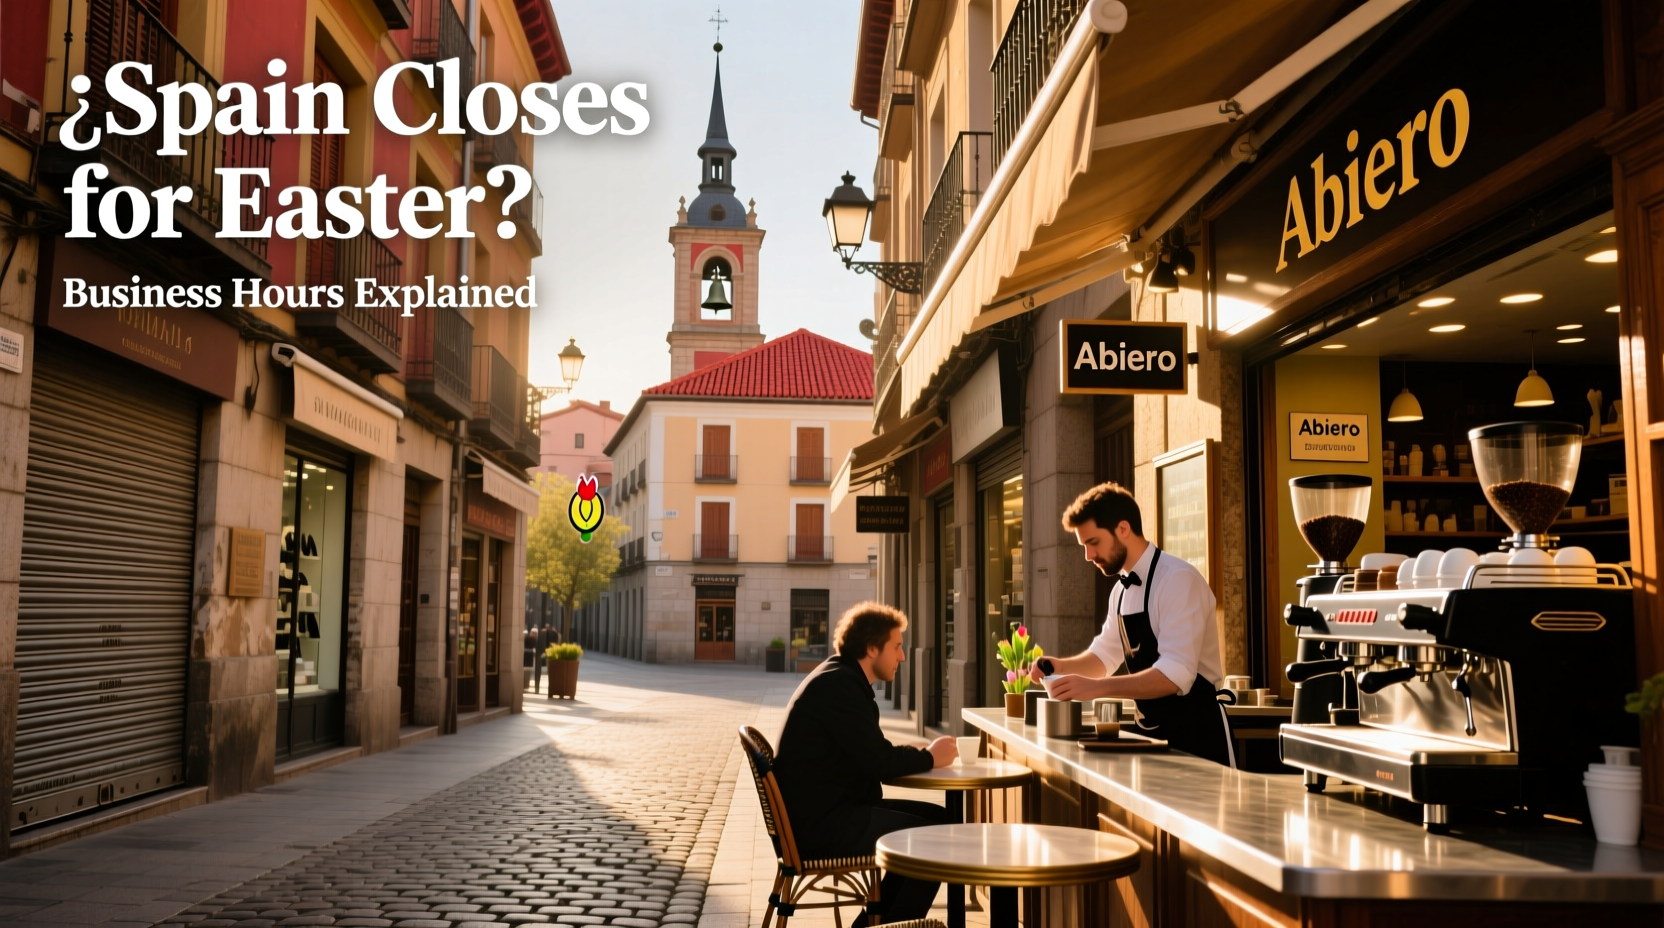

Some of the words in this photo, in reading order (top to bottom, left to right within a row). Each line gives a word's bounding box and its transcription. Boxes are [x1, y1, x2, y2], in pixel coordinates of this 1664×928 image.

[1275, 88, 1470, 274] Abiero
[1074, 342, 1177, 372] Abiero
[1299, 418, 1361, 437] Abiero
